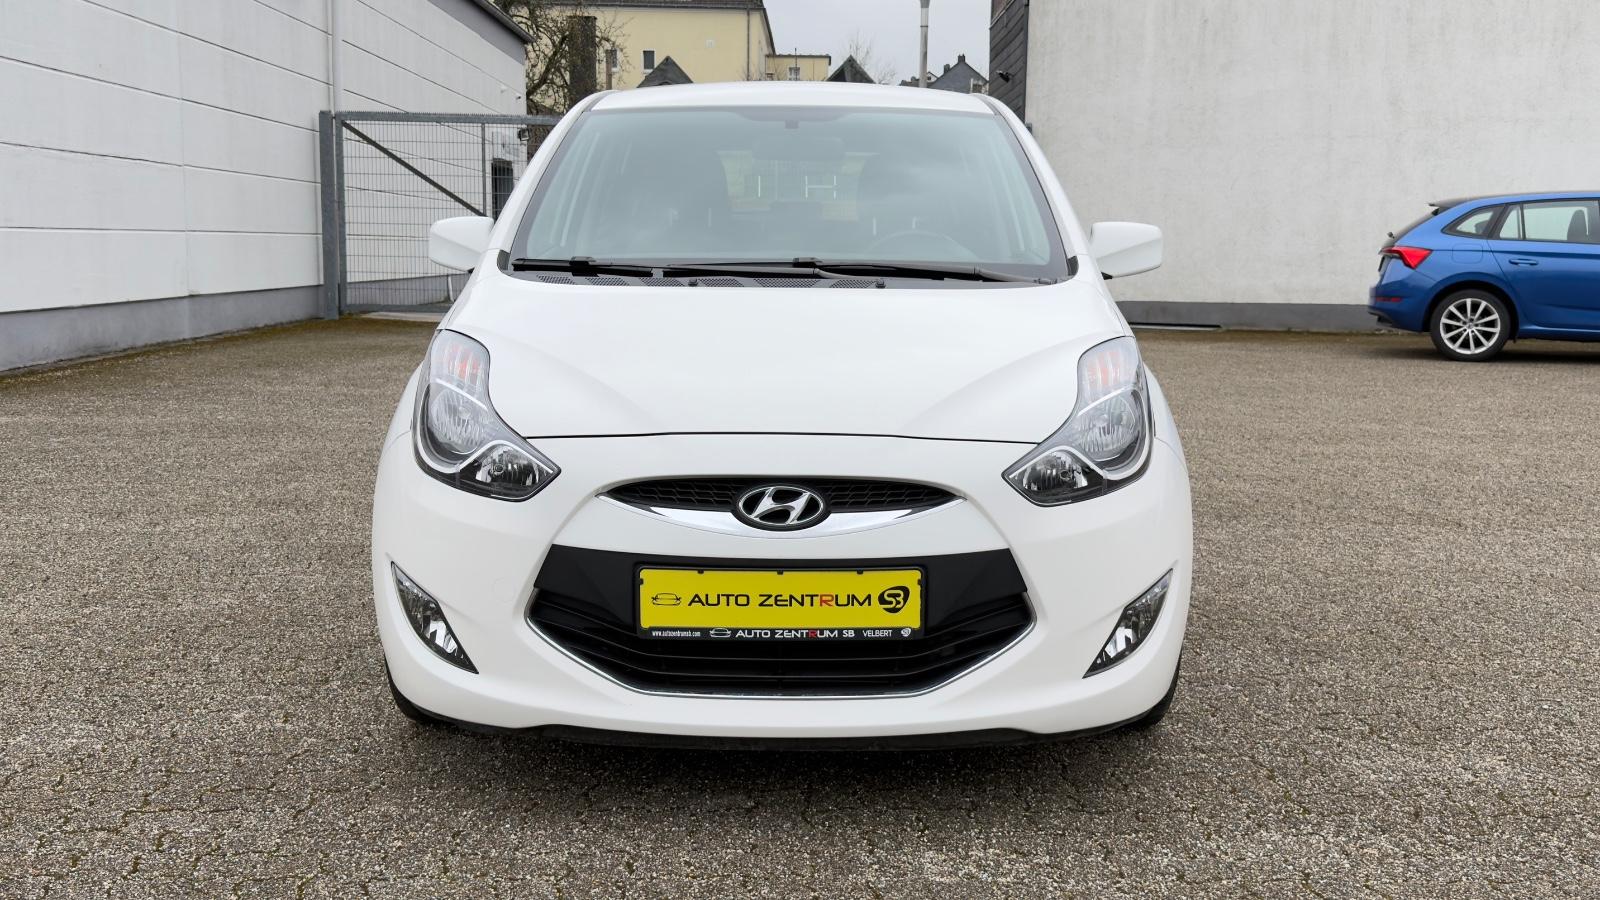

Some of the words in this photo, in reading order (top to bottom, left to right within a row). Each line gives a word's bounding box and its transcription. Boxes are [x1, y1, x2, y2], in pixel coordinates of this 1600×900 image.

[688, 593, 750, 607] AUTO
[758, 594, 872, 607] ZENTRUM
[735, 629, 771, 638] AUTO
[774, 629, 838, 638] ZENTRUM
[842, 629, 855, 638] SB
[862, 629, 893, 638] VELBERT
